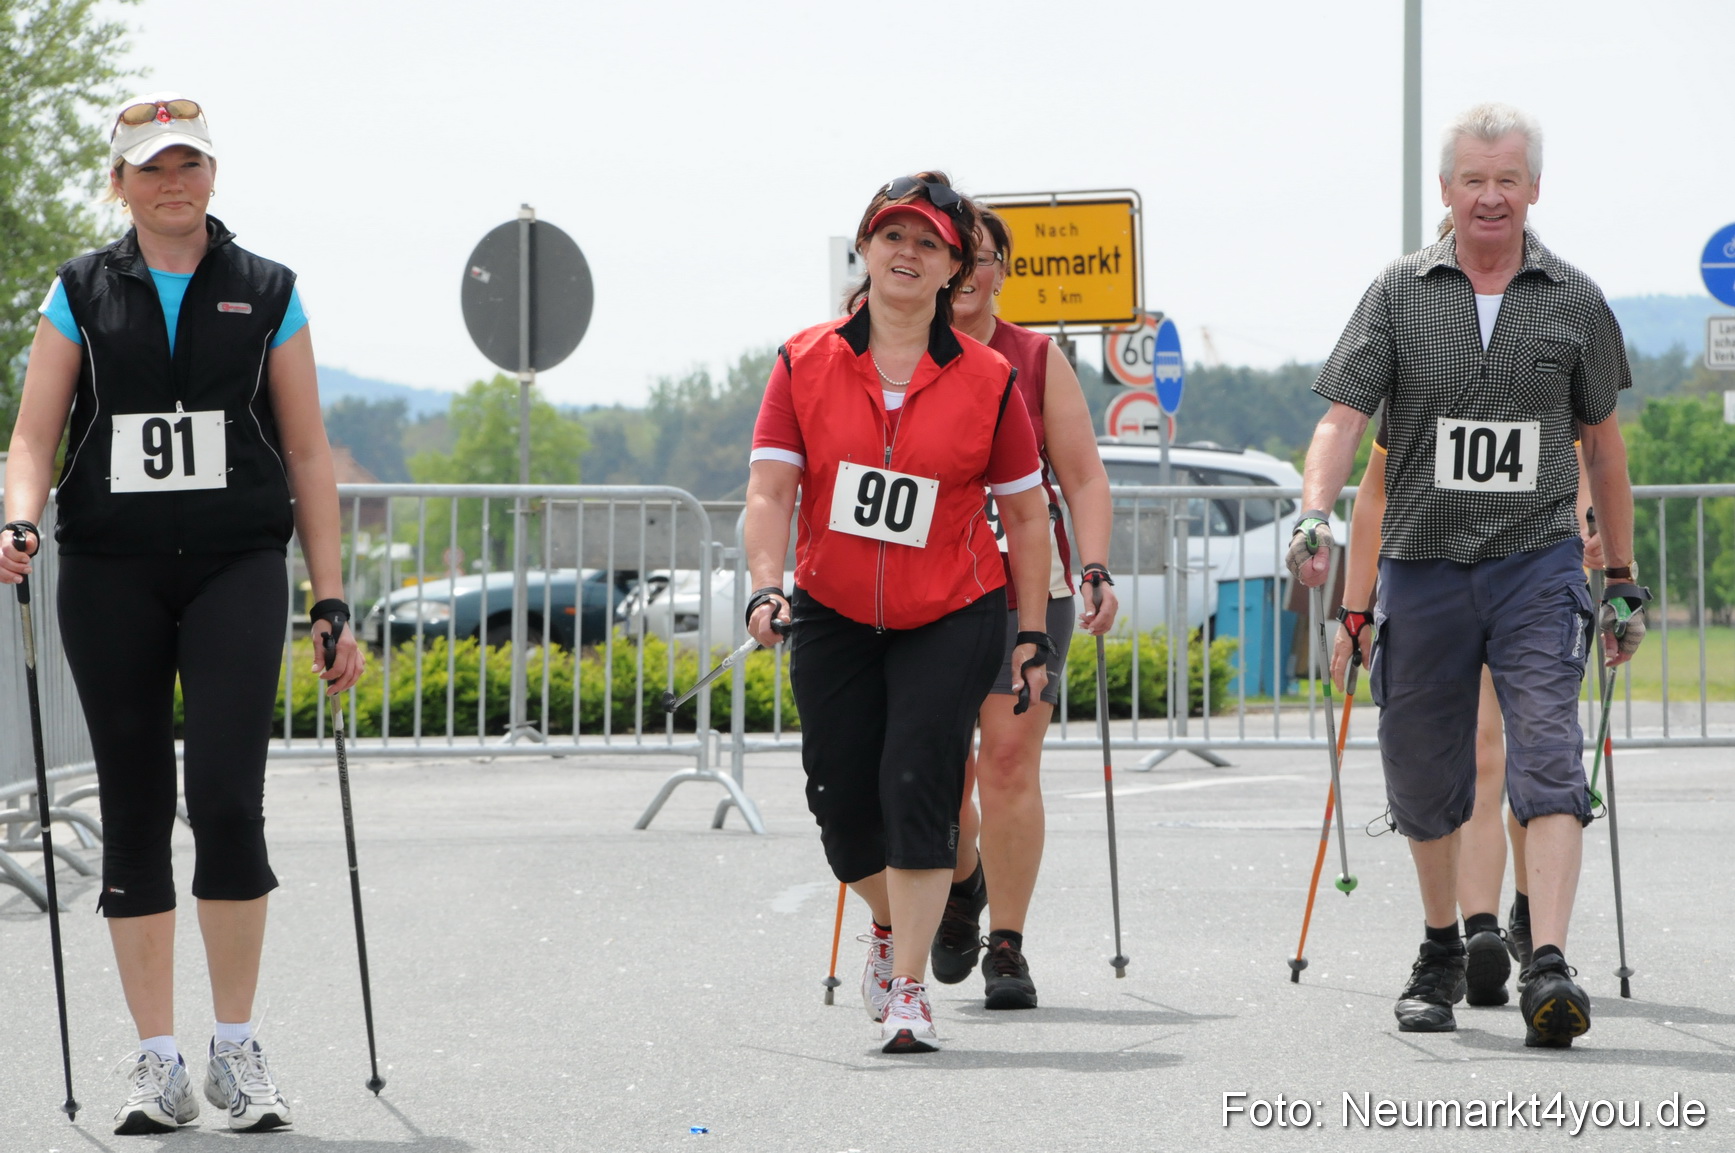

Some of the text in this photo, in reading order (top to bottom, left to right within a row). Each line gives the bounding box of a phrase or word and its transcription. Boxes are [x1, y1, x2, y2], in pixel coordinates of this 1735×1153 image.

[1035, 223, 1079, 238] Nach
[1006, 246, 1121, 277] eumarkt
[1038, 289, 1083, 304] 5 km
[1123, 335, 1155, 366] 60
[142, 416, 195, 480] 91
[1449, 426, 1523, 483] 104
[854, 471, 919, 533] 90
